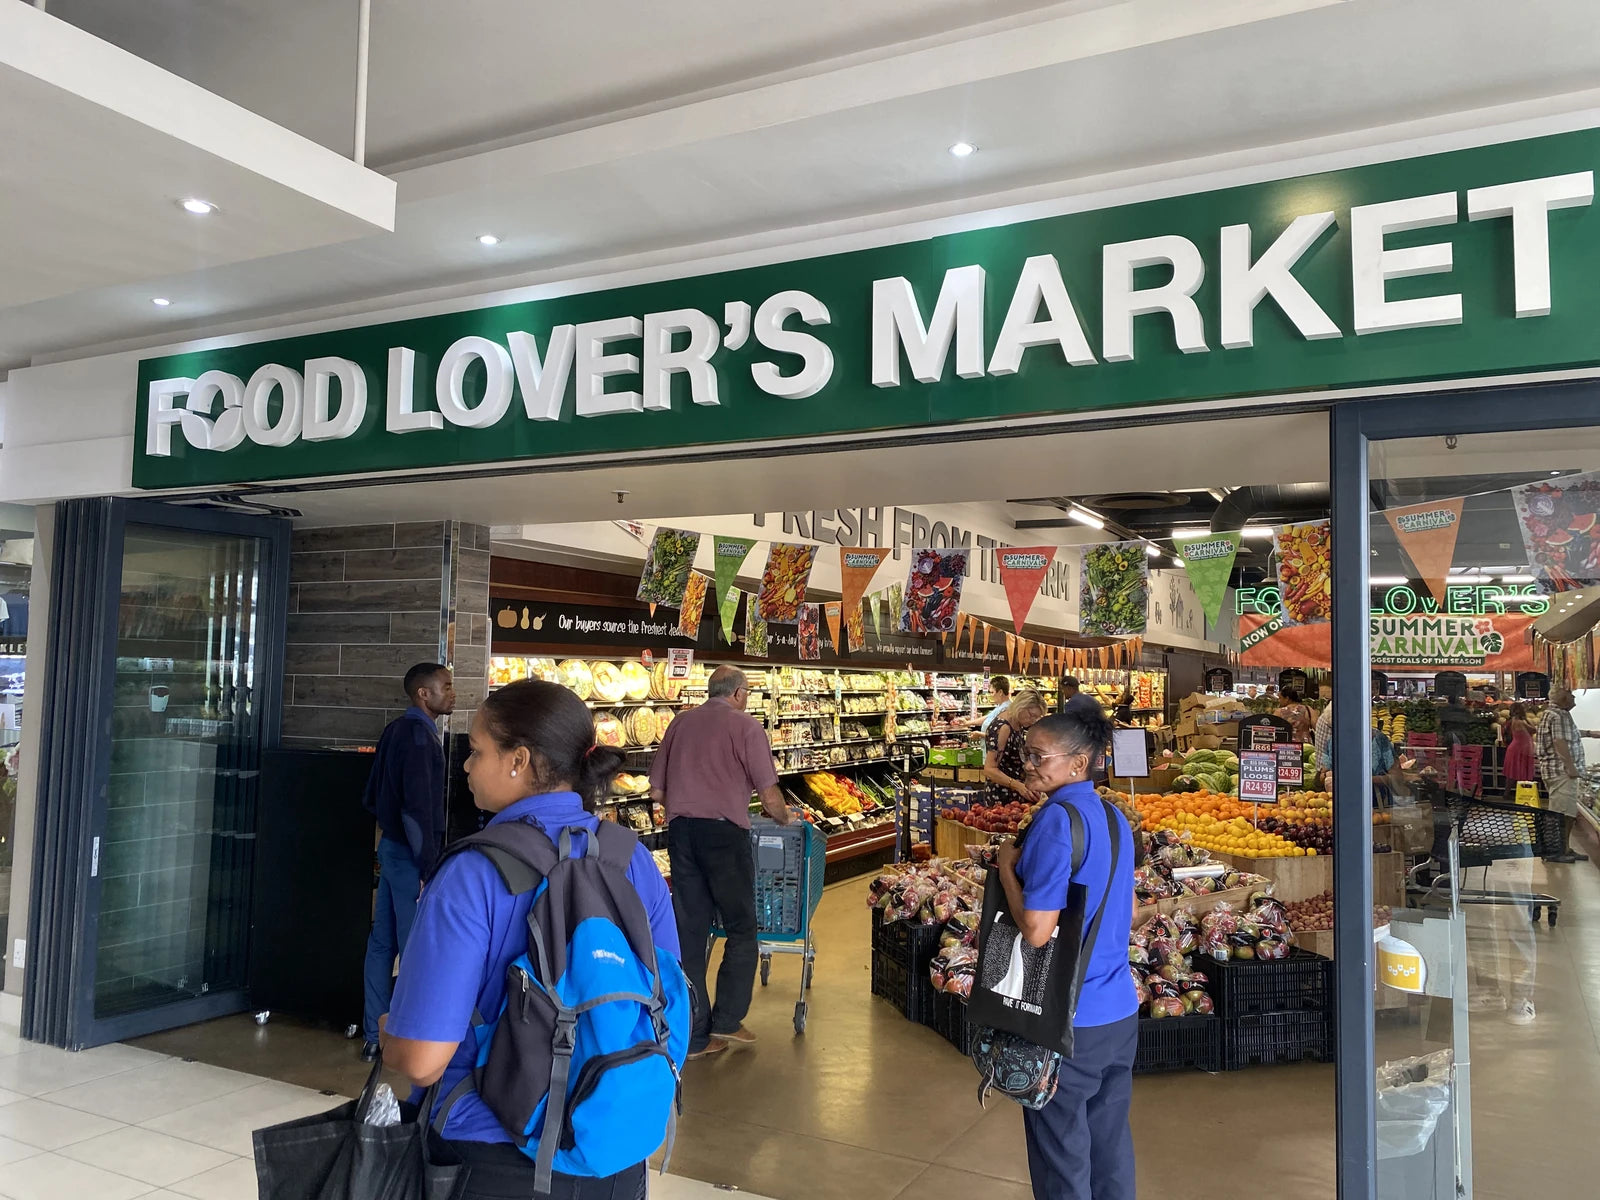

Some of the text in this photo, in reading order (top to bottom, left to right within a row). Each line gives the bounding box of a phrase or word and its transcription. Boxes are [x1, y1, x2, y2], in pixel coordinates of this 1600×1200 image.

[146, 170, 1595, 457] FOOD LOVER'S MARKET
[1404, 510, 1445, 522] SUMMER
[1403, 517, 1450, 529] CARNIVAL
[1189, 547, 1229, 557] CARNIVAL
[1190, 541, 1226, 551] SUMMER
[558, 614, 573, 630] Our
[575, 615, 601, 633] buyers
[602, 621, 626, 633] source
[628, 619, 639, 634] the
[641, 620, 667, 636] freshest
[1370, 618, 1476, 637] SUMMER
[1241, 627, 1269, 648] NOW
[1396, 657, 1420, 665] DEALS
[1421, 657, 1433, 665] OF
[1450, 658, 1482, 666] SEASON
[1243, 765, 1275, 773] PLUMS
[1245, 781, 1273, 792] R24.99
